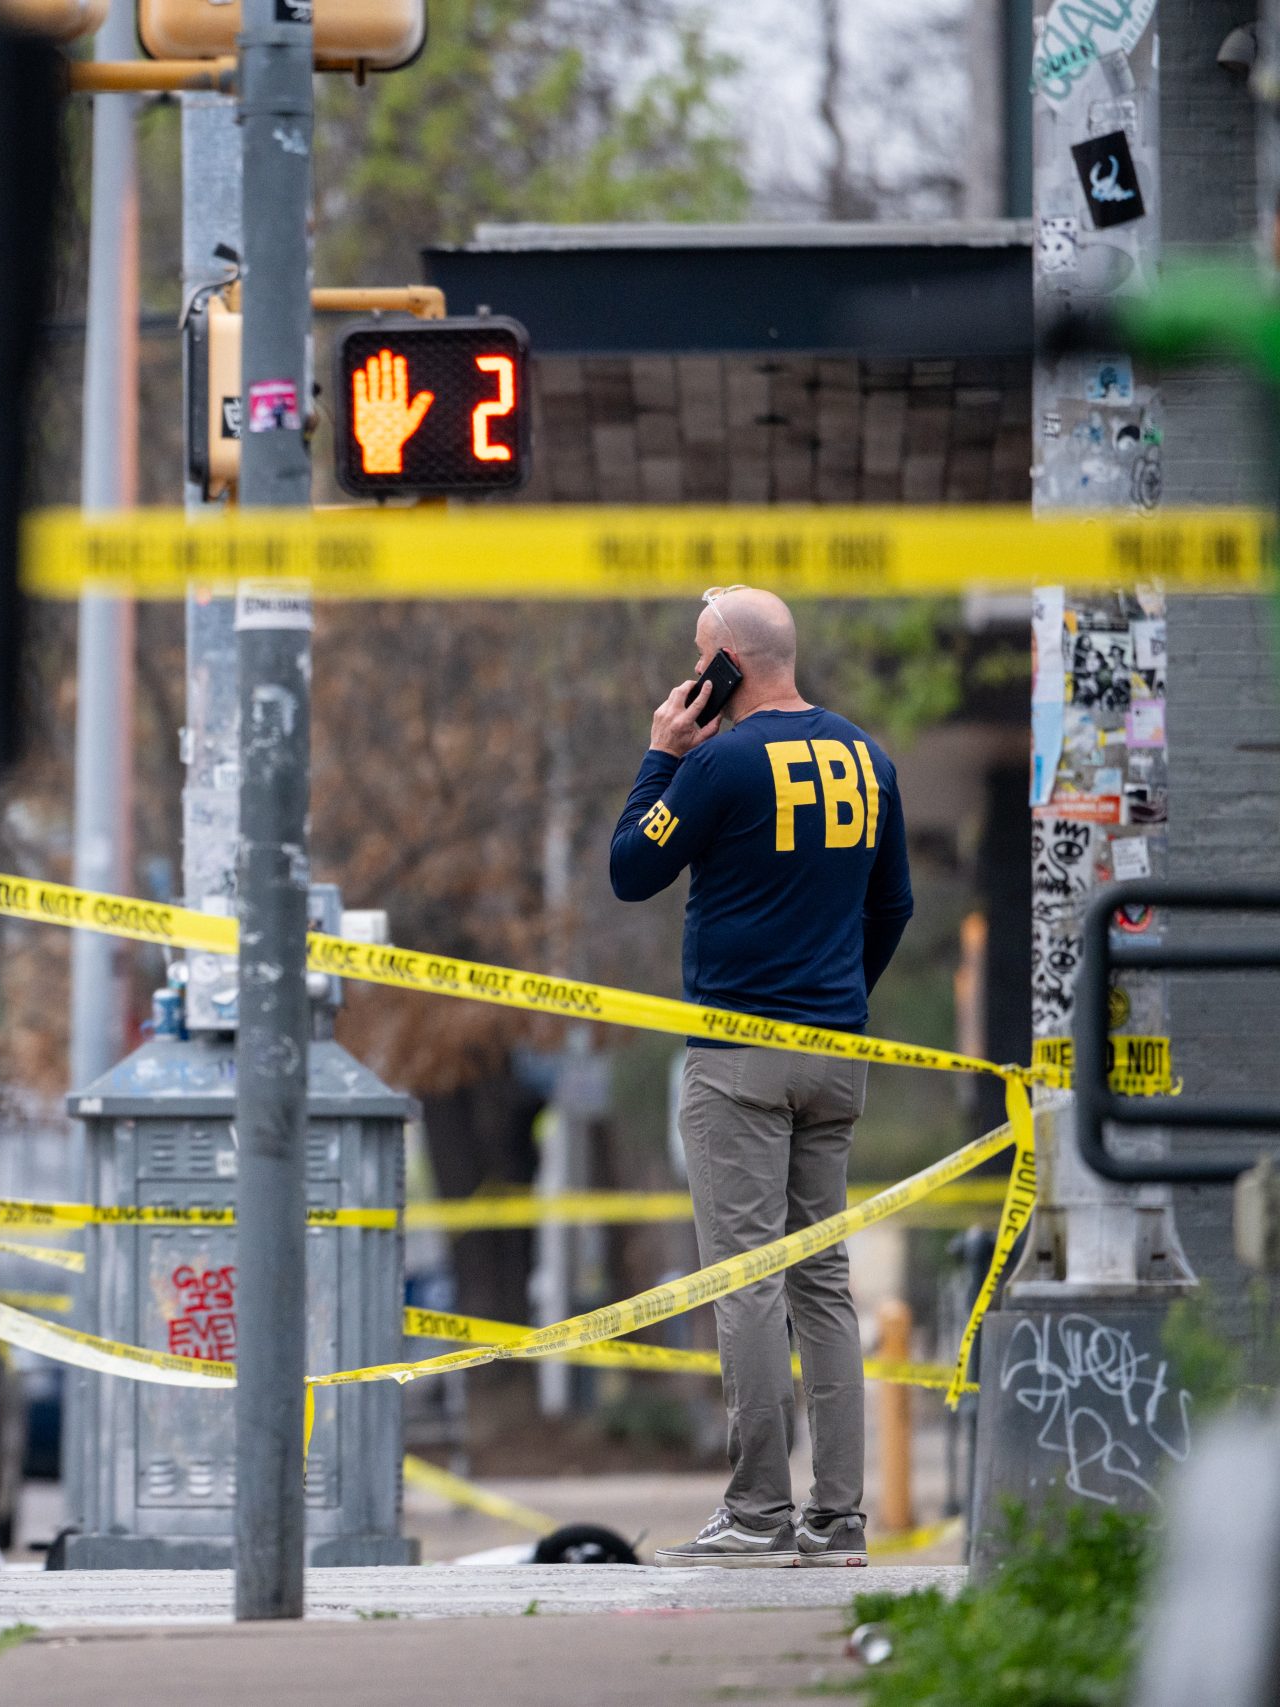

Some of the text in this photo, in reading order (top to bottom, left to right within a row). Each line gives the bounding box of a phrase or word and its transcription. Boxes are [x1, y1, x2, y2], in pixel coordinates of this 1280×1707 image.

[472, 355, 515, 461] 2
[639, 800, 680, 847] FBI
[764, 739, 880, 852] FBI
[39, 888, 86, 922] NOT
[92, 897, 172, 937] CROSS
[365, 948, 420, 982] LINE
[427, 960, 460, 990] DO
[469, 968, 513, 998] NOT
[520, 978, 603, 1014] CROSS
[1127, 1041, 1164, 1075] NOT
